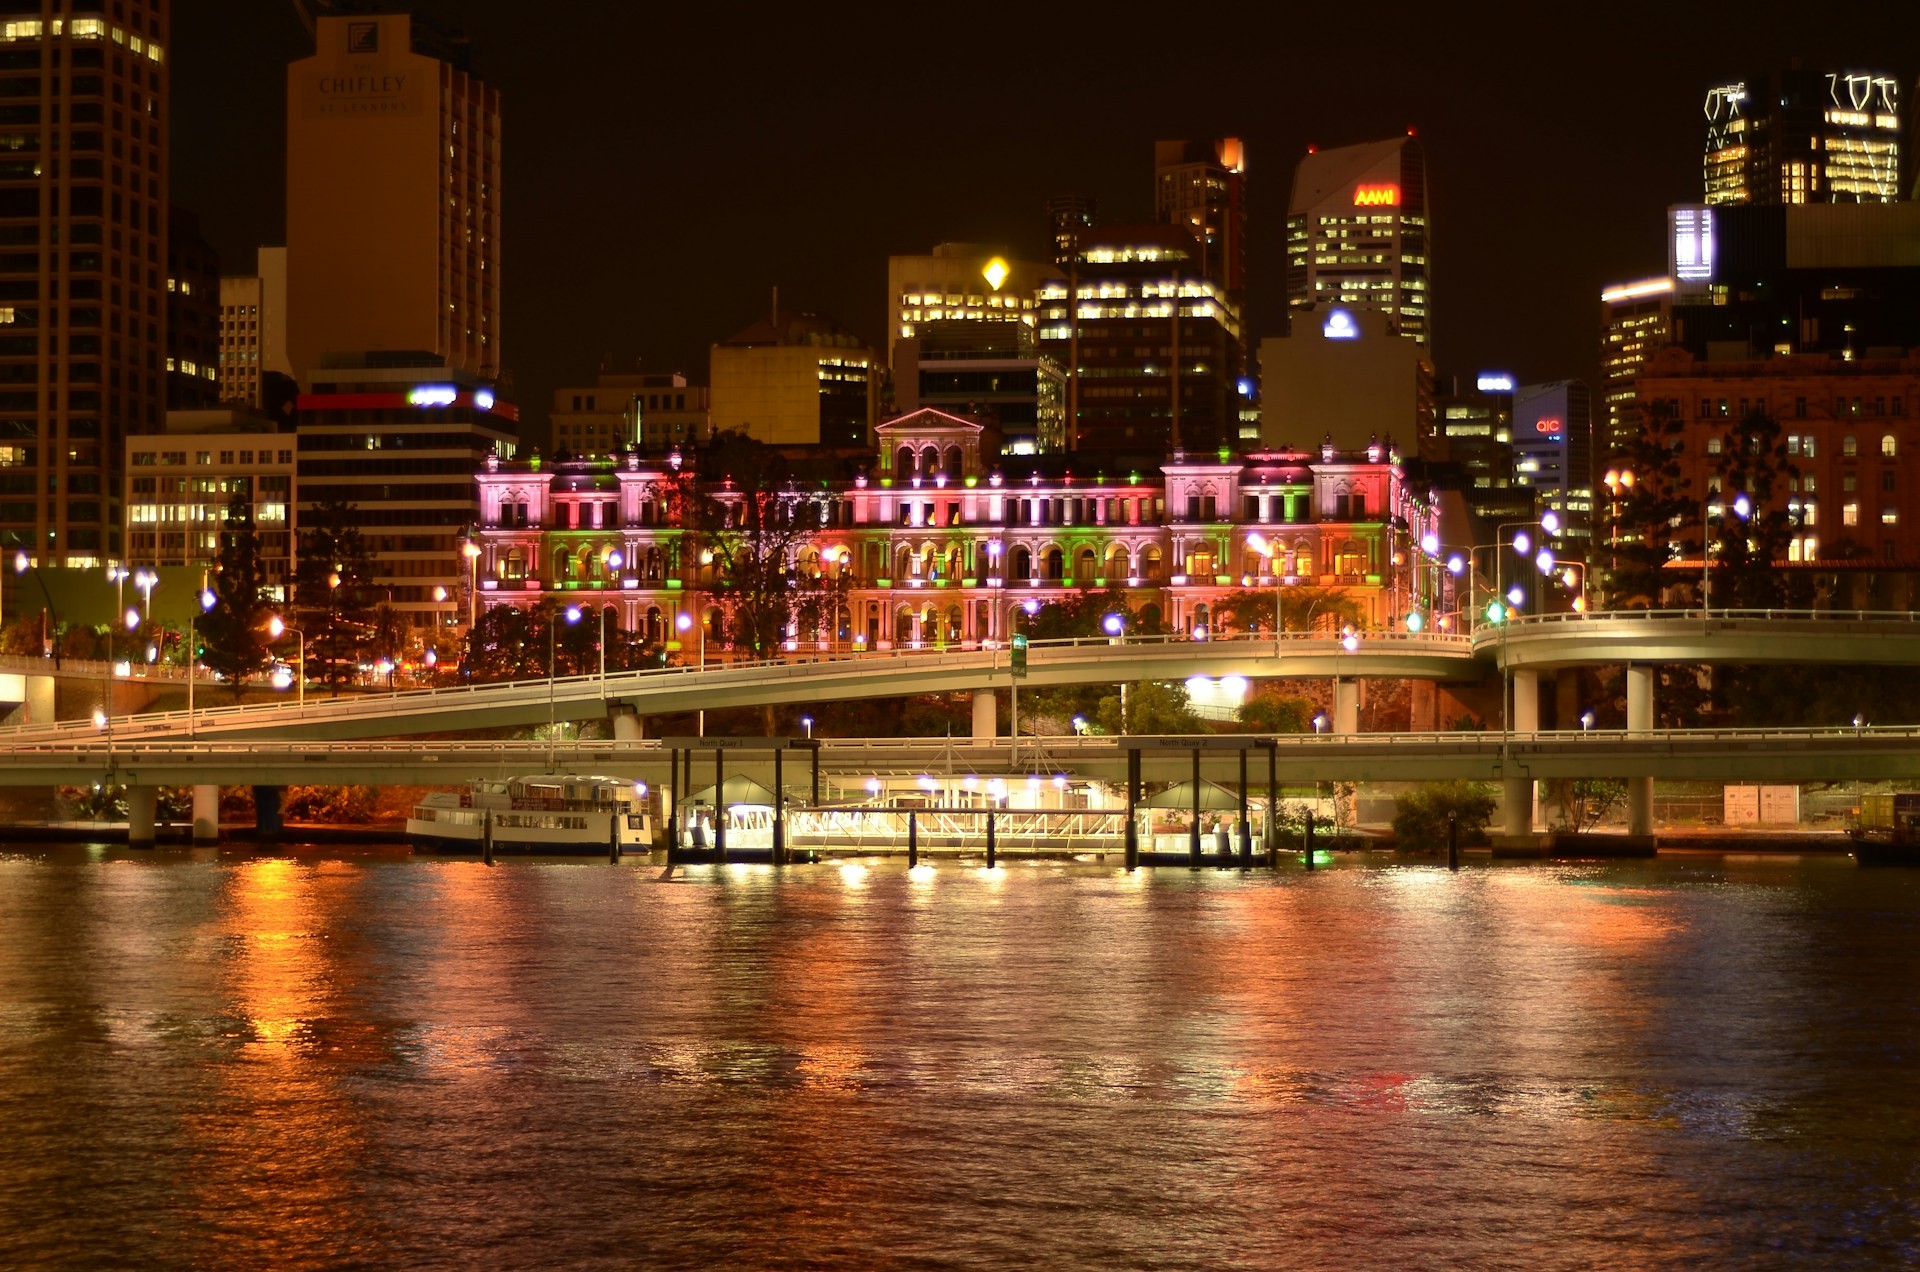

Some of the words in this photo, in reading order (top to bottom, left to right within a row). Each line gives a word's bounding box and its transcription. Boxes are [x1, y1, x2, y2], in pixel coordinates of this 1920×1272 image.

[319, 75, 406, 93] CHIFLEY
[343, 102, 407, 112] LENNONS
[1354, 187, 1396, 206] AAMI
[699, 739, 718, 747] North
[719, 739, 737, 748] Quay
[1159, 739, 1179, 747] North
[1181, 739, 1200, 748] Quay
[1202, 739, 1208, 747] 2
